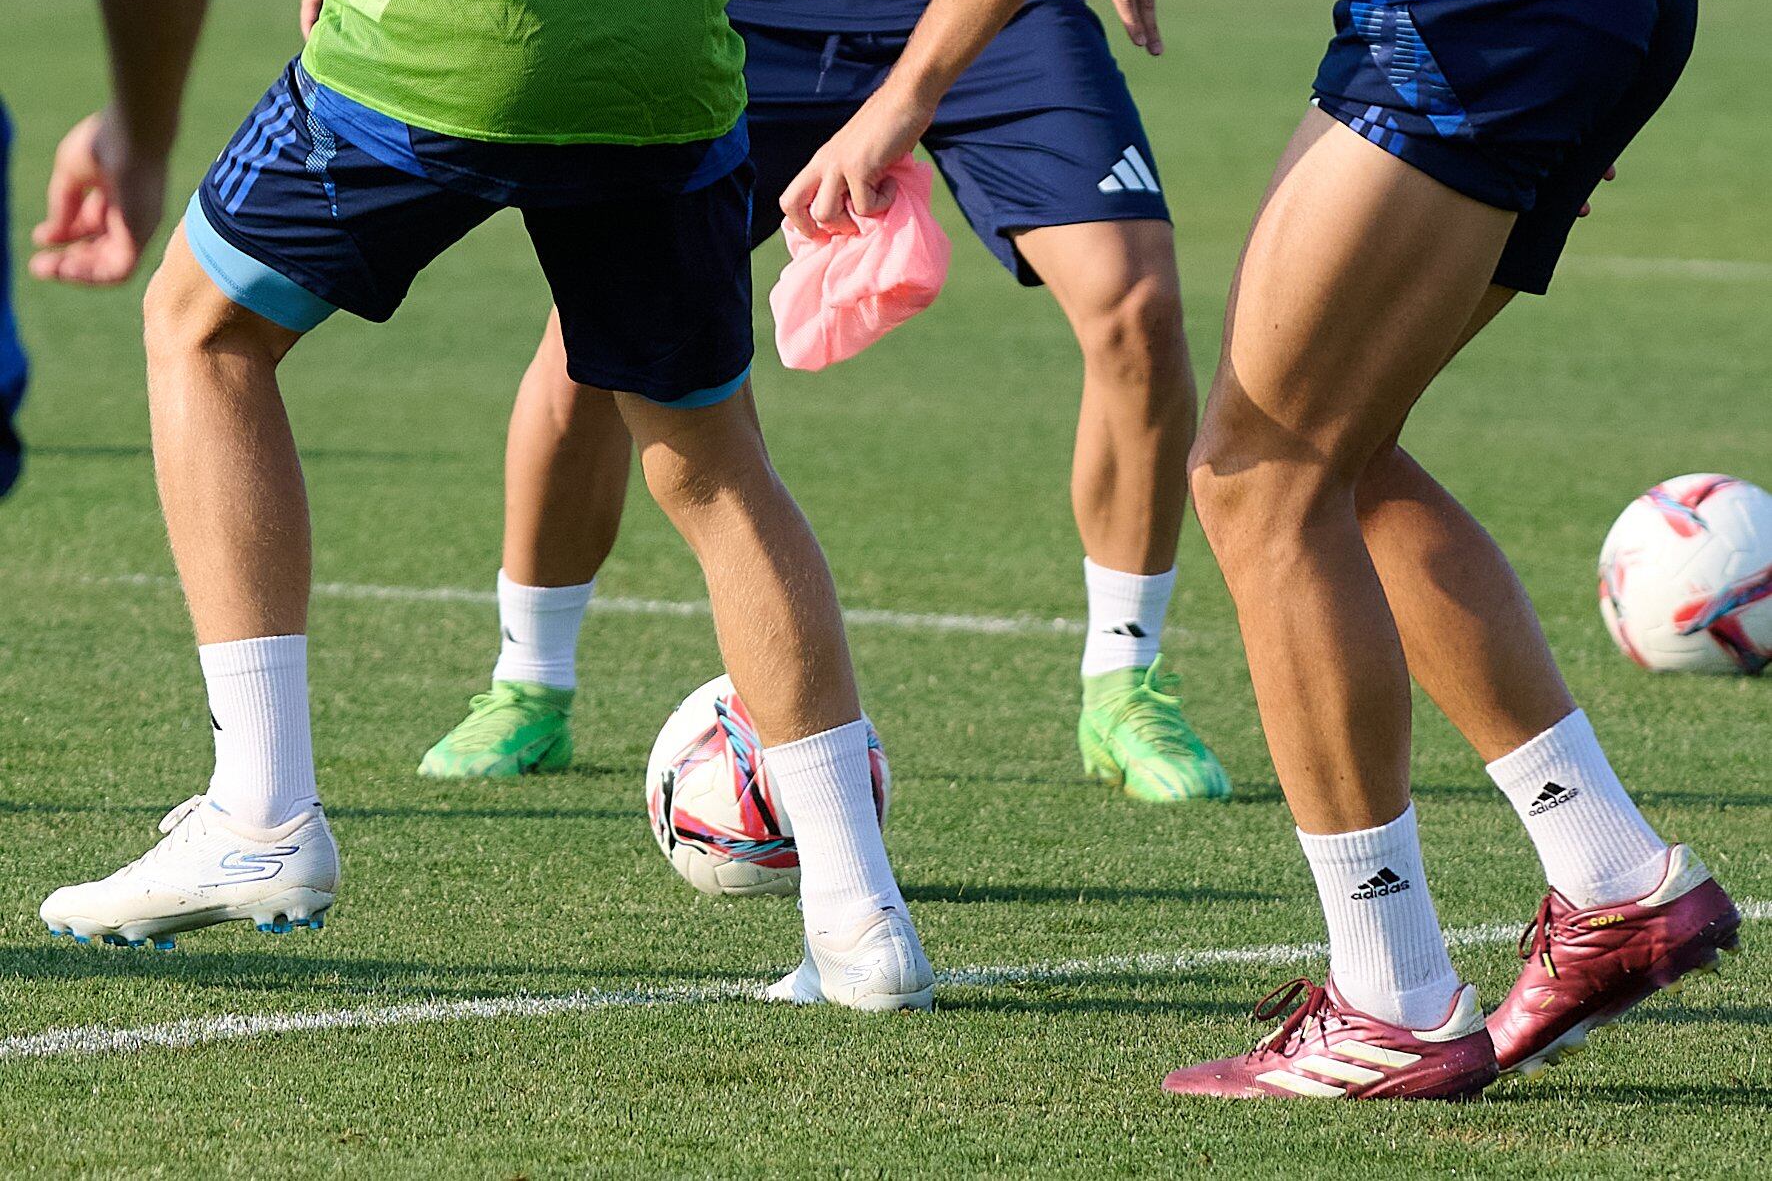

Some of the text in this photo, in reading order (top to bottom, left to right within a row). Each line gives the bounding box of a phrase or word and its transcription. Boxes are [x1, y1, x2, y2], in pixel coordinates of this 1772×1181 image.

[1528, 787, 1579, 817] adidas
[1350, 879, 1410, 900] adidas
[1589, 913, 1625, 927] COPA
